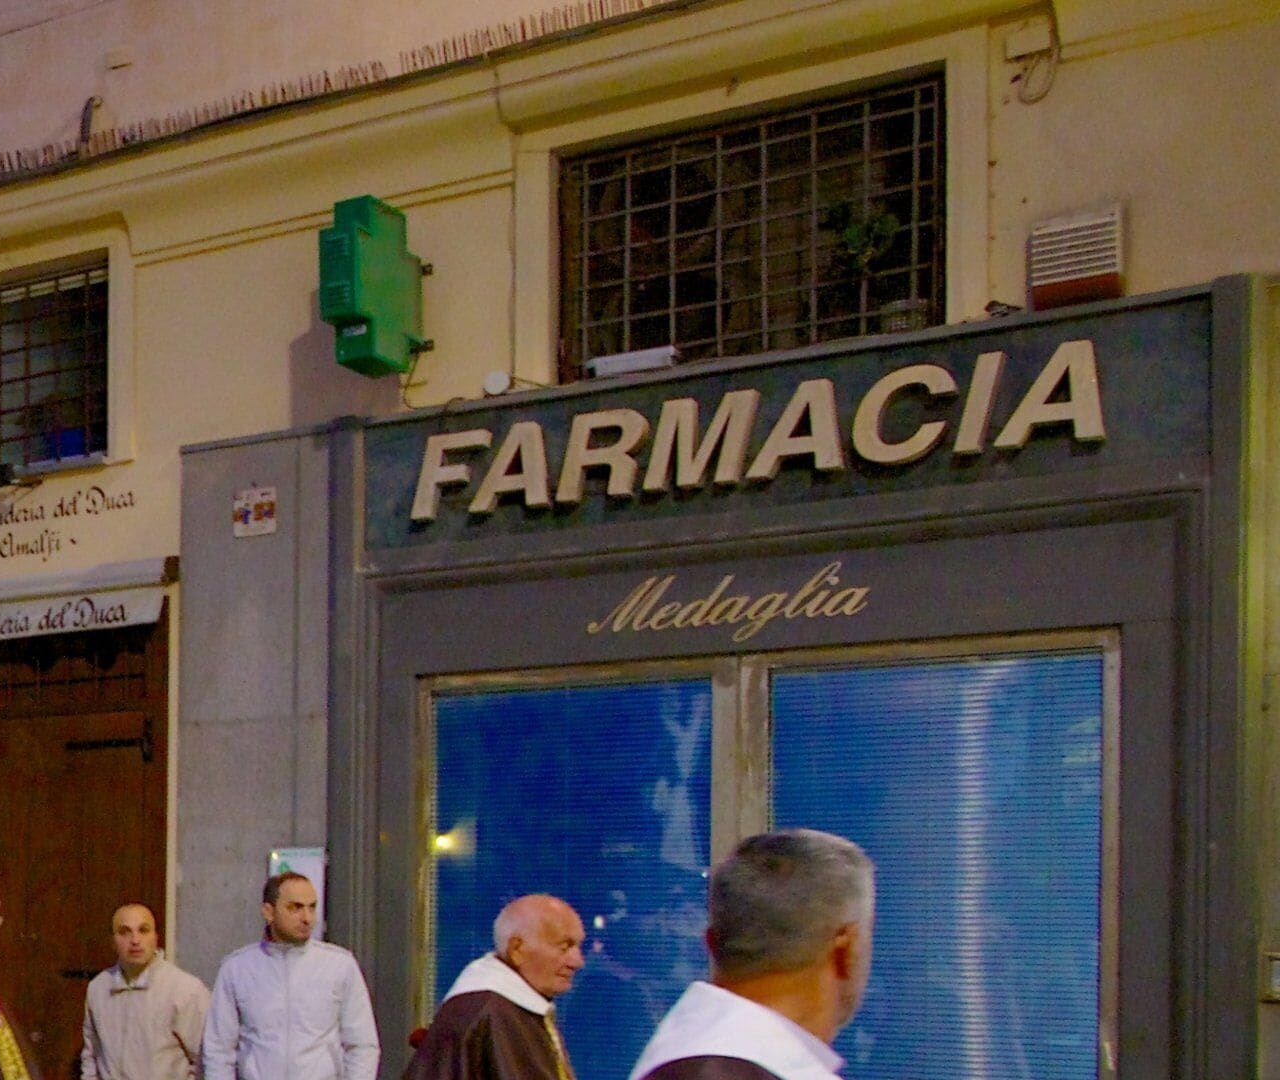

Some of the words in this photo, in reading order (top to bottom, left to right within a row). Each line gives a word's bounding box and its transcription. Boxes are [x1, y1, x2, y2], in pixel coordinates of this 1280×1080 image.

[409, 338, 1107, 522] FARMACIA
[53, 490, 82, 518] del
[86, 485, 135, 515] Duca
[37, 601, 72, 630] del
[73, 597, 127, 627] Duca
[586, 560, 872, 643] Medaglia
